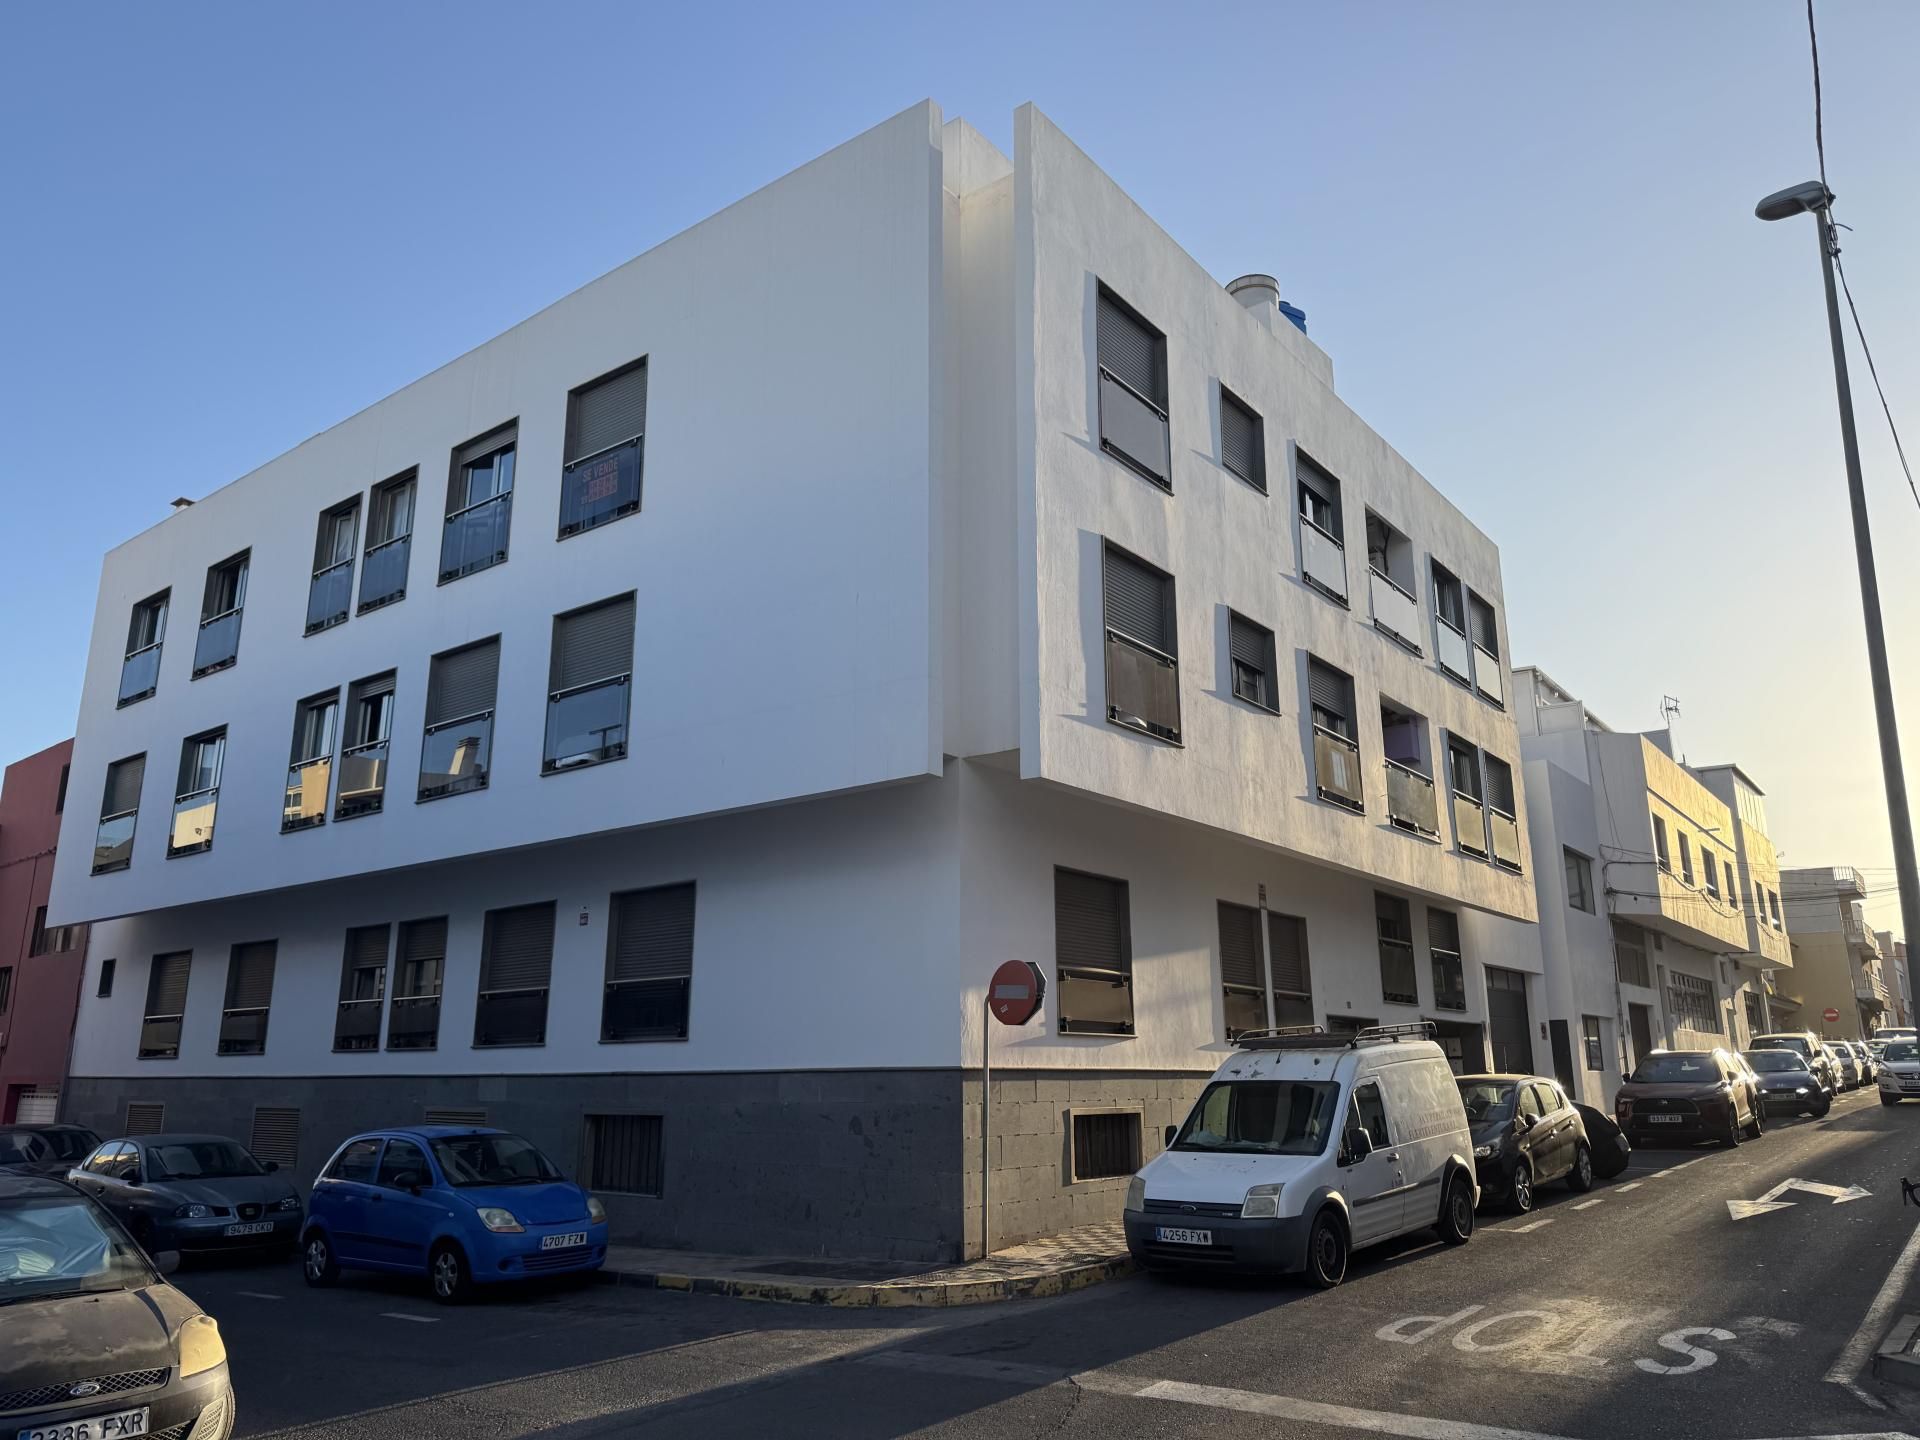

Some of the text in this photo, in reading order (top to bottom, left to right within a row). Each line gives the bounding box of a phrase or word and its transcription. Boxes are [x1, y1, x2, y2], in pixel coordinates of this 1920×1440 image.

[593, 459, 617, 477] VENDE
[543, 1233, 585, 1248] 4707 FZW
[1163, 1229, 1209, 1243] 4256 FXW
[102, 1412, 144, 1439] FXR
